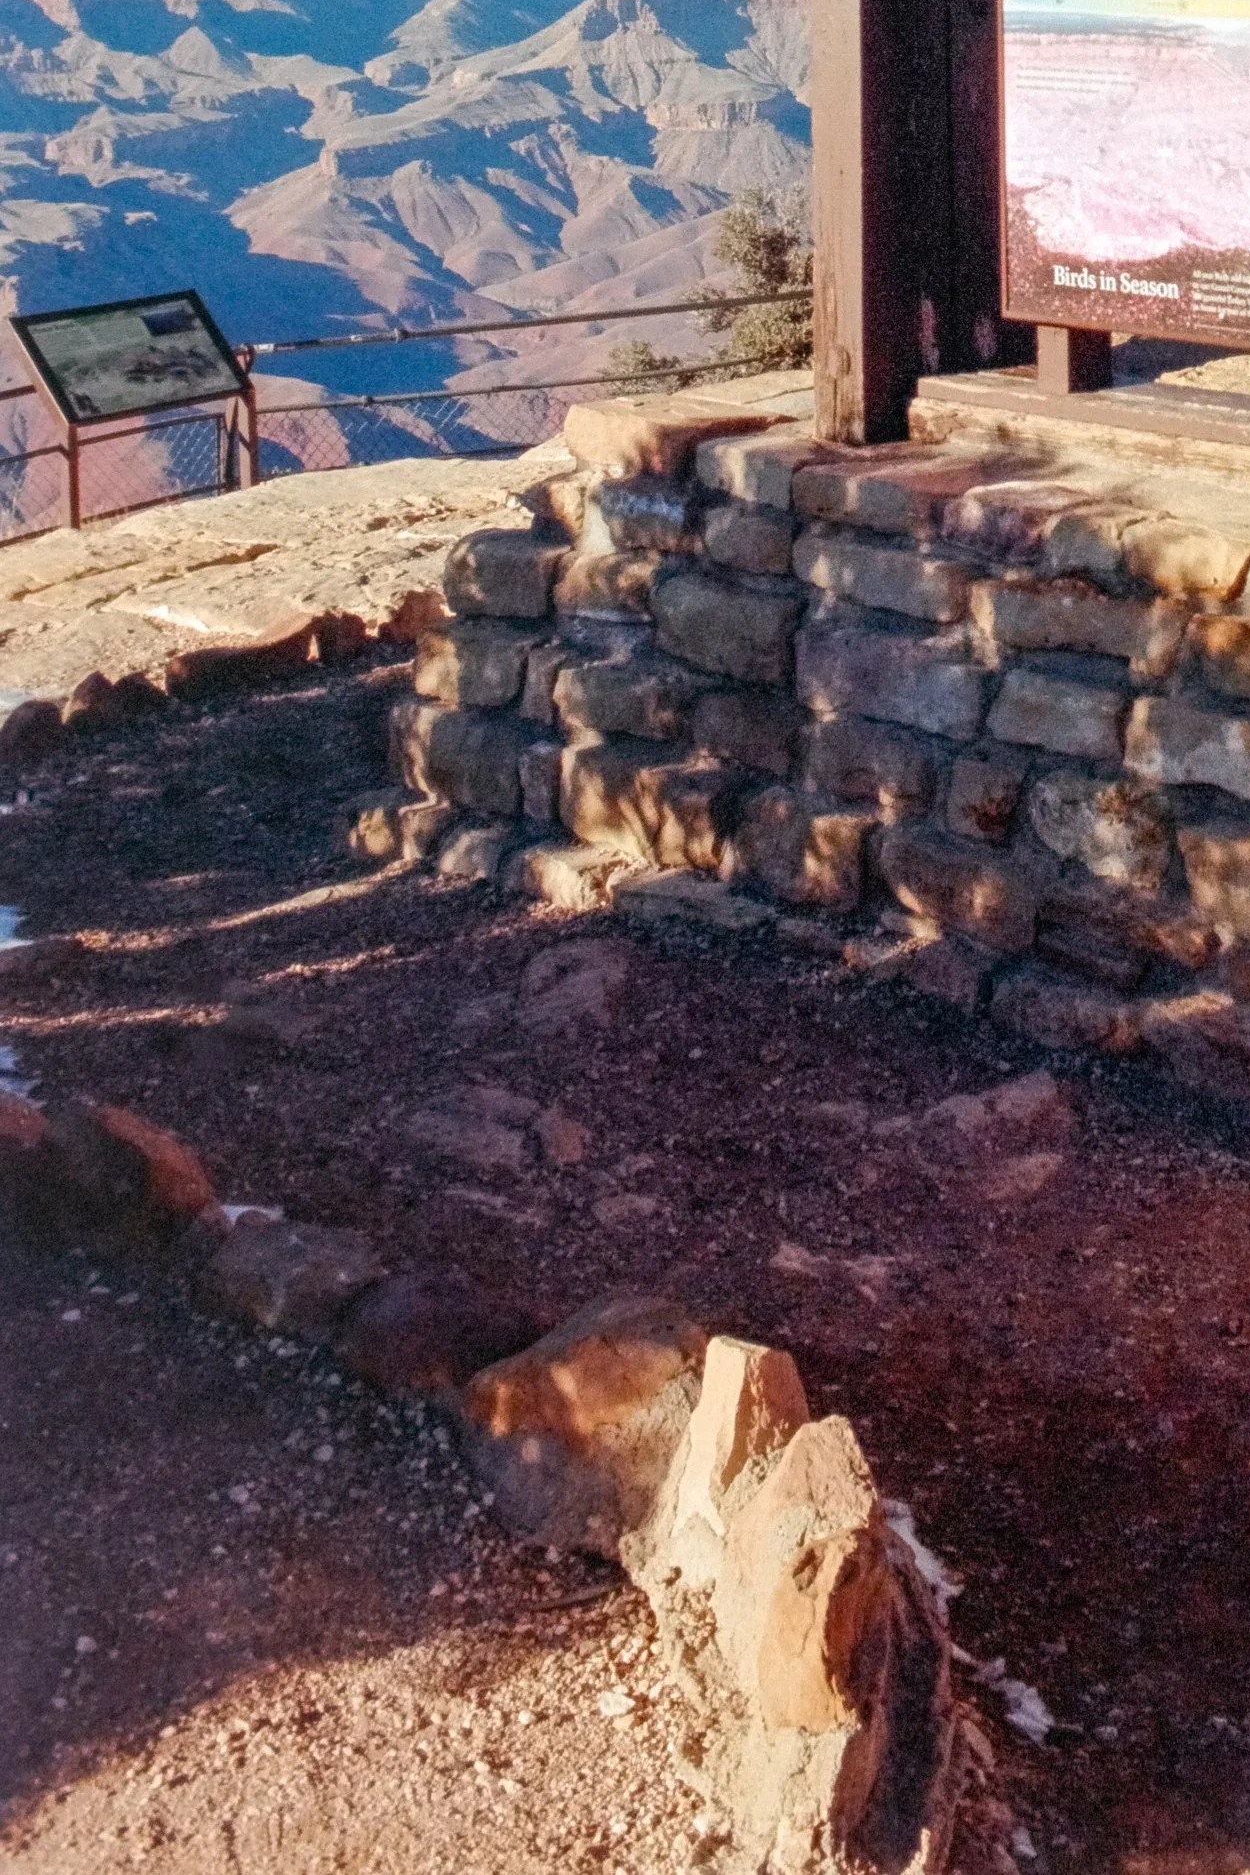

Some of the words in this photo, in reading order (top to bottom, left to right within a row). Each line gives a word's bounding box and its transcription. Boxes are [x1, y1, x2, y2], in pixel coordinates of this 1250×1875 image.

[1053, 265, 1097, 289] Birds
[1100, 270, 1117, 292] in
[1120, 272, 1179, 299] Season
